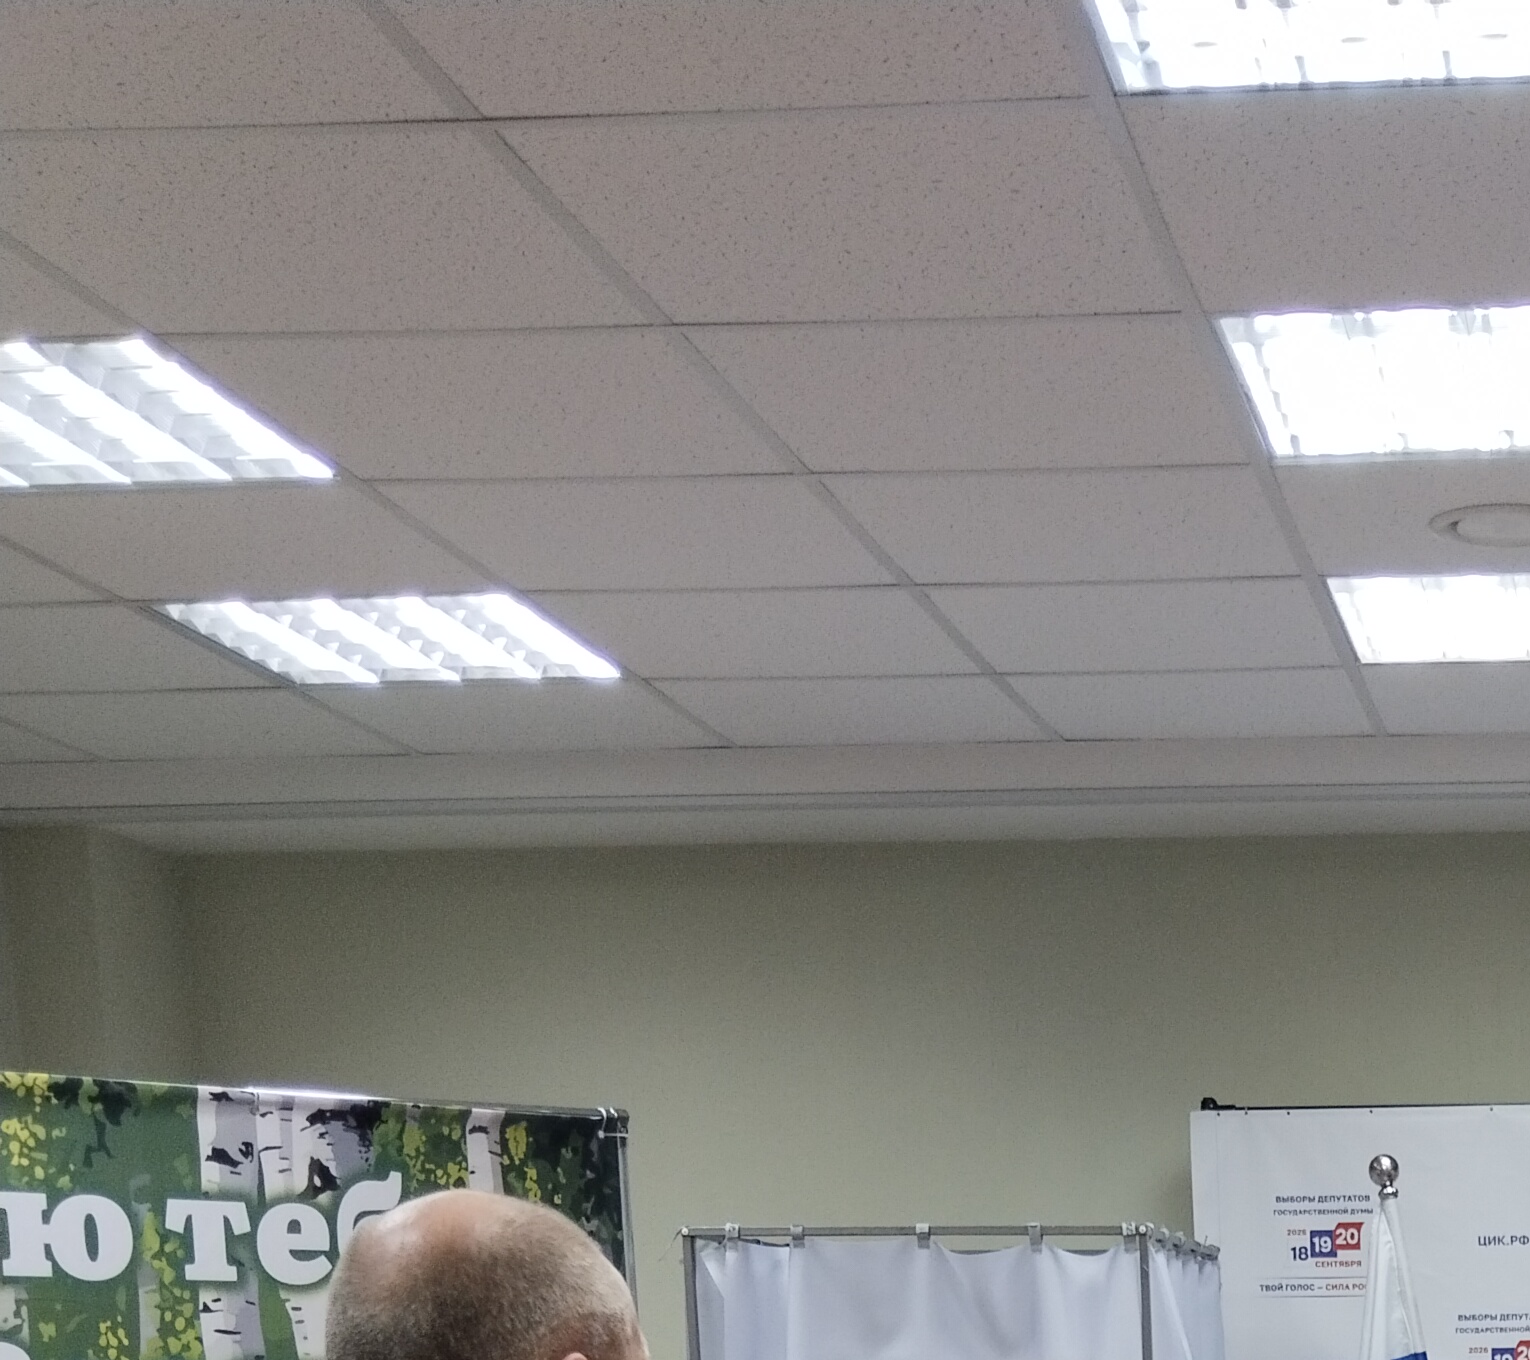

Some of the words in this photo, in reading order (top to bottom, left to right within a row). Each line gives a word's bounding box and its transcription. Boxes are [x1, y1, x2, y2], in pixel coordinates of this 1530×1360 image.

[1318, 1195, 1370, 1203] ДЕПУТАТОВ
[1274, 1208, 1348, 1216] ГОСУДАРСТВЕННОЙ
[1291, 1246, 1308, 1261] 18
[1312, 1236, 1332, 1252] 19
[1335, 1228, 1358, 1245] 20
[1478, 1235, 1529, 1247] ЦИК.РФ
[1260, 1283, 1283, 1292] ТВОЙ
[1456, 1325, 1530, 1334] ГОСУДАРСТВЕННОЙ
